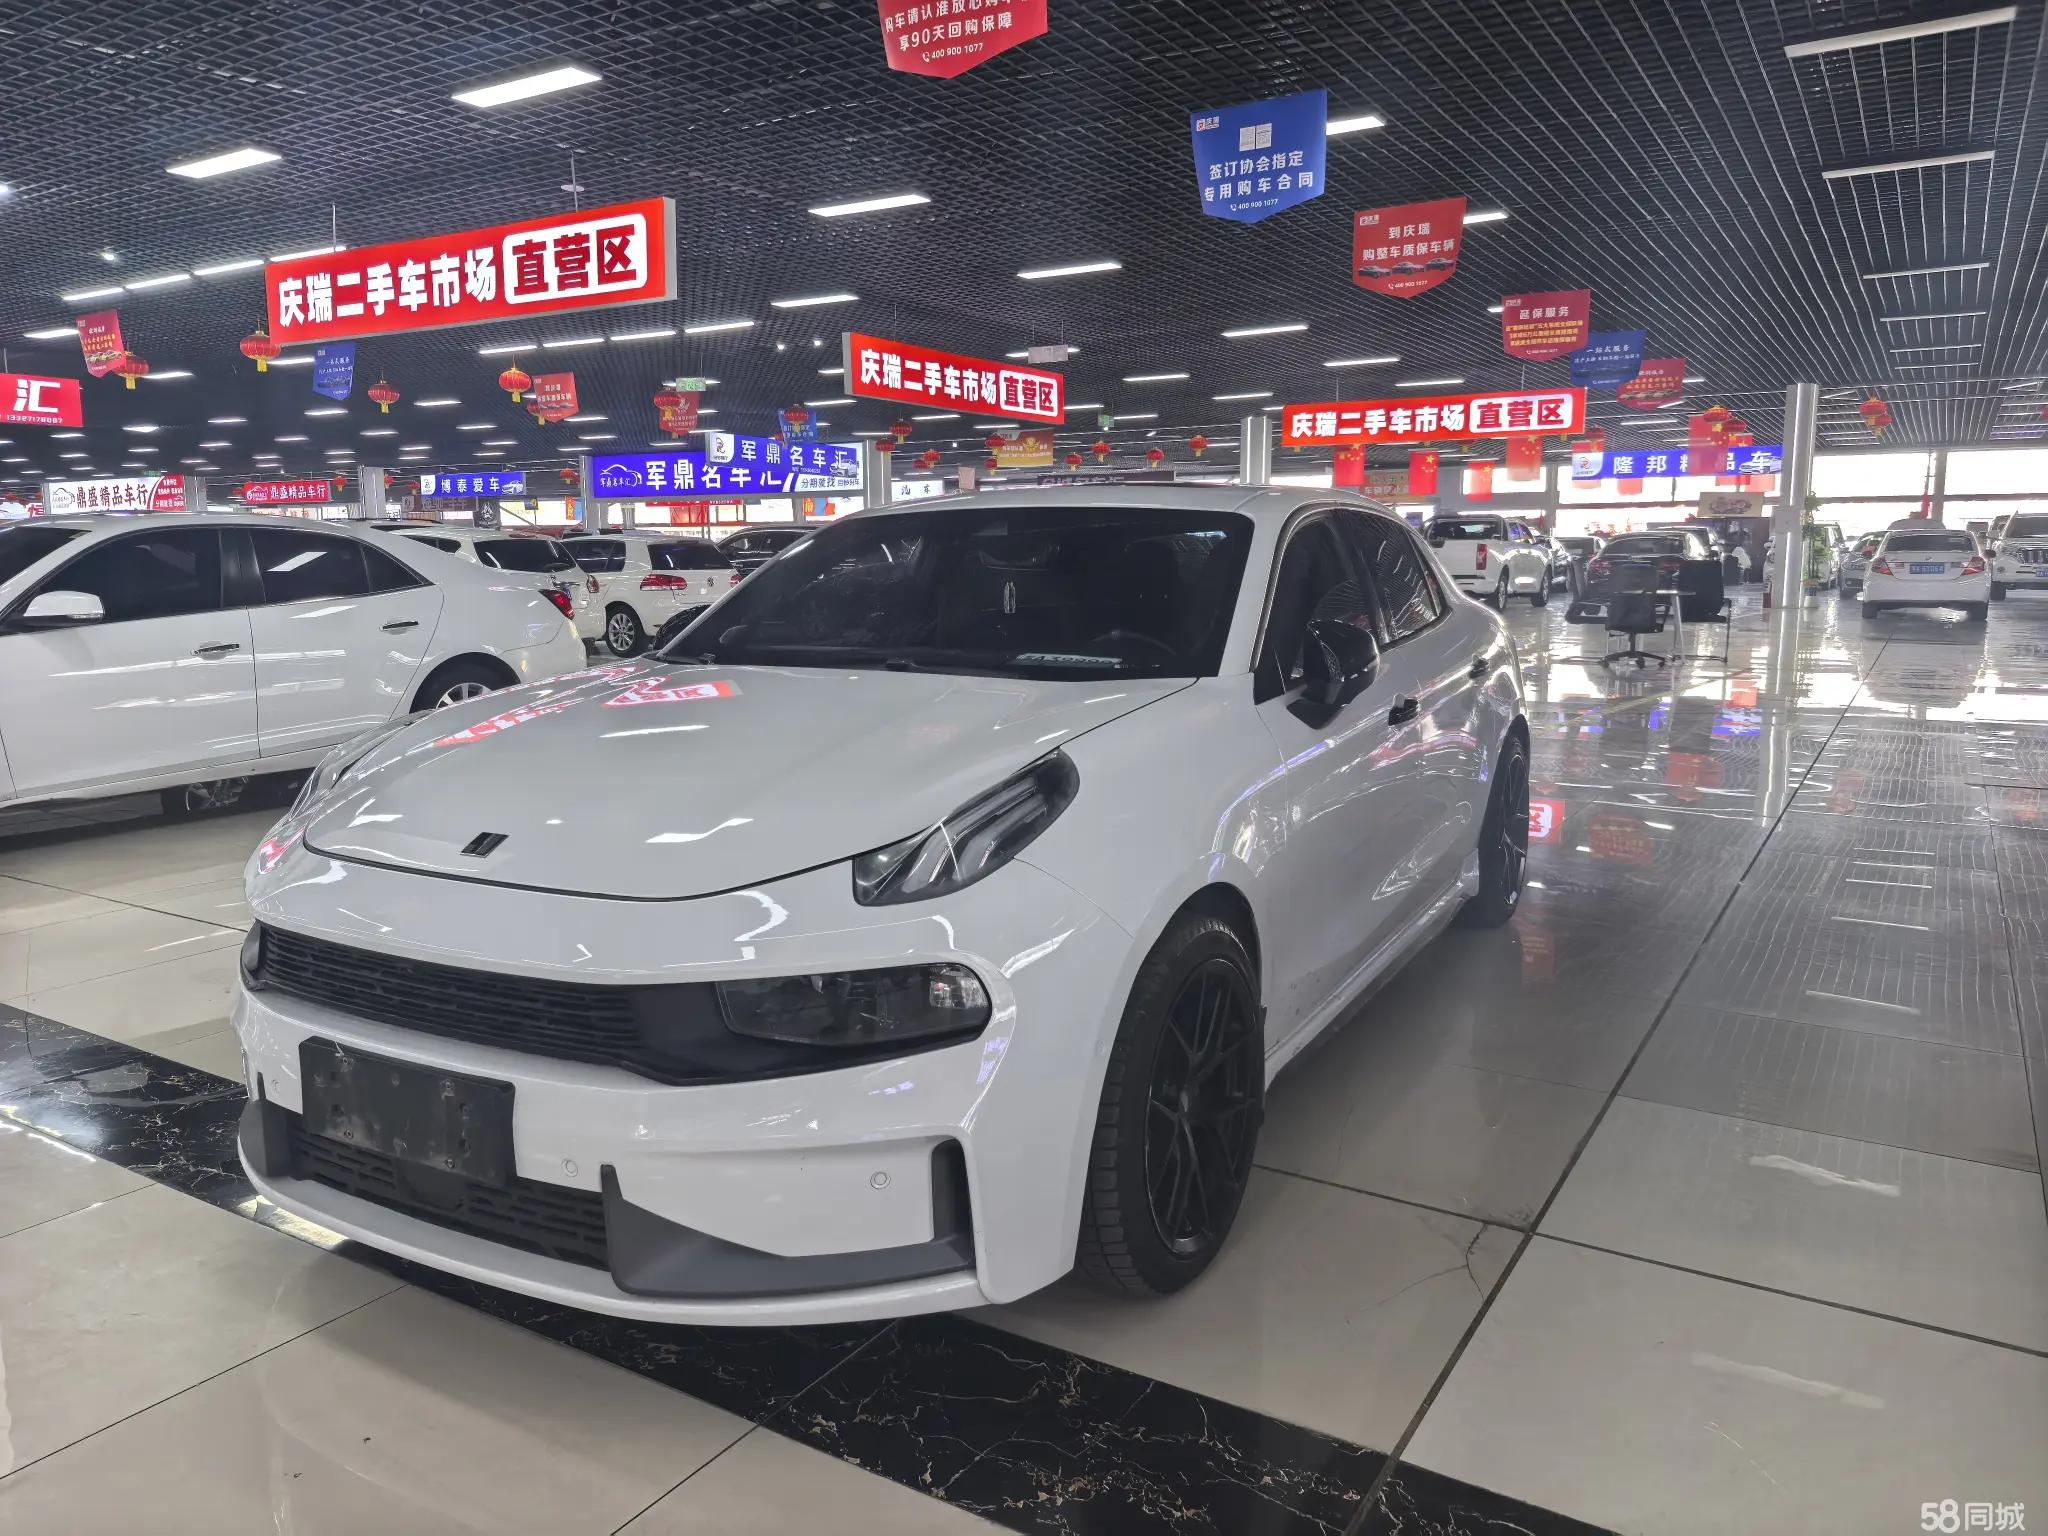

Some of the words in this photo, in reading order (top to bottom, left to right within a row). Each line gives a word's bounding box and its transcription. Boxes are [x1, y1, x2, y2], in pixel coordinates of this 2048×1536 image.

[899, 12, 1013, 51] 享90天回购保障
[931, 49, 945, 60] 400
[947, 46, 962, 56] 900
[964, 43, 984, 53] 1077
[1209, 151, 1304, 180] 签订协会指定
[1204, 172, 1313, 202] 专用购车合同
[1264, 198, 1279, 206] 1077
[1388, 222, 1431, 239] 到庆瑞
[1362, 238, 1455, 261] 购整车质保车辆
[278, 246, 496, 328] 庆瑞二手车市场
[512, 223, 637, 296] 直营区
[1519, 306, 1569, 319] 延保服务
[861, 349, 996, 404] 庆瑞二手车市场
[1003, 376, 1054, 413] 直营区
[13, 379, 60, 413] 汇
[1291, 404, 1464, 438] 庆瑞二手车市场
[1477, 398, 1565, 427] 直营区
[741, 439, 848, 469] 军鼎名车汇
[76, 483, 148, 509] 鼎盛精品车行
[270, 484, 327, 499] 鼎盛精品车行
[441, 477, 500, 494] 博泰爱车
